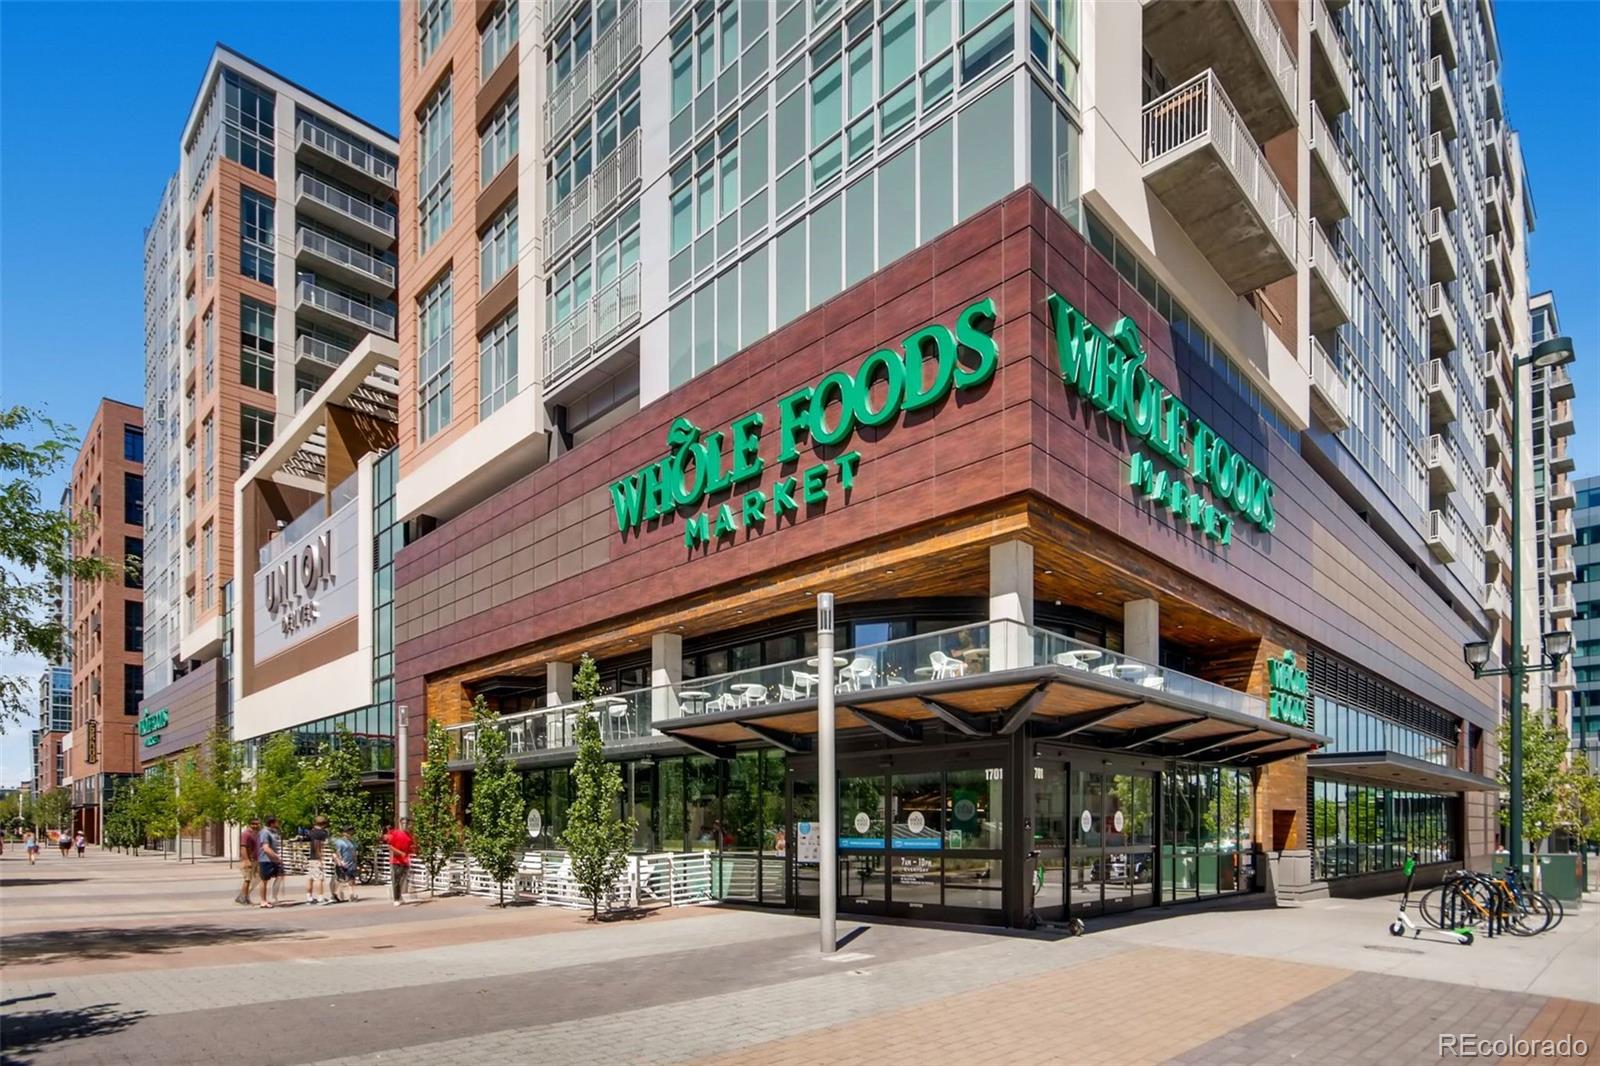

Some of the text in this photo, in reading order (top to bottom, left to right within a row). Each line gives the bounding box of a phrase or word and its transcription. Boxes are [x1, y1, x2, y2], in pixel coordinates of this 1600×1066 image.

[609, 297, 999, 532] WHOLE FOODS
[1047, 292, 1275, 533] WHOLE FOODS
[684, 451, 861, 548] MARKET
[1130, 453, 1234, 545] MARKET
[266, 529, 335, 613] UNION
[1267, 650, 1309, 697] WHOLE
[1269, 690, 1308, 727] FOODS
[985, 768, 1003, 780] 1701
